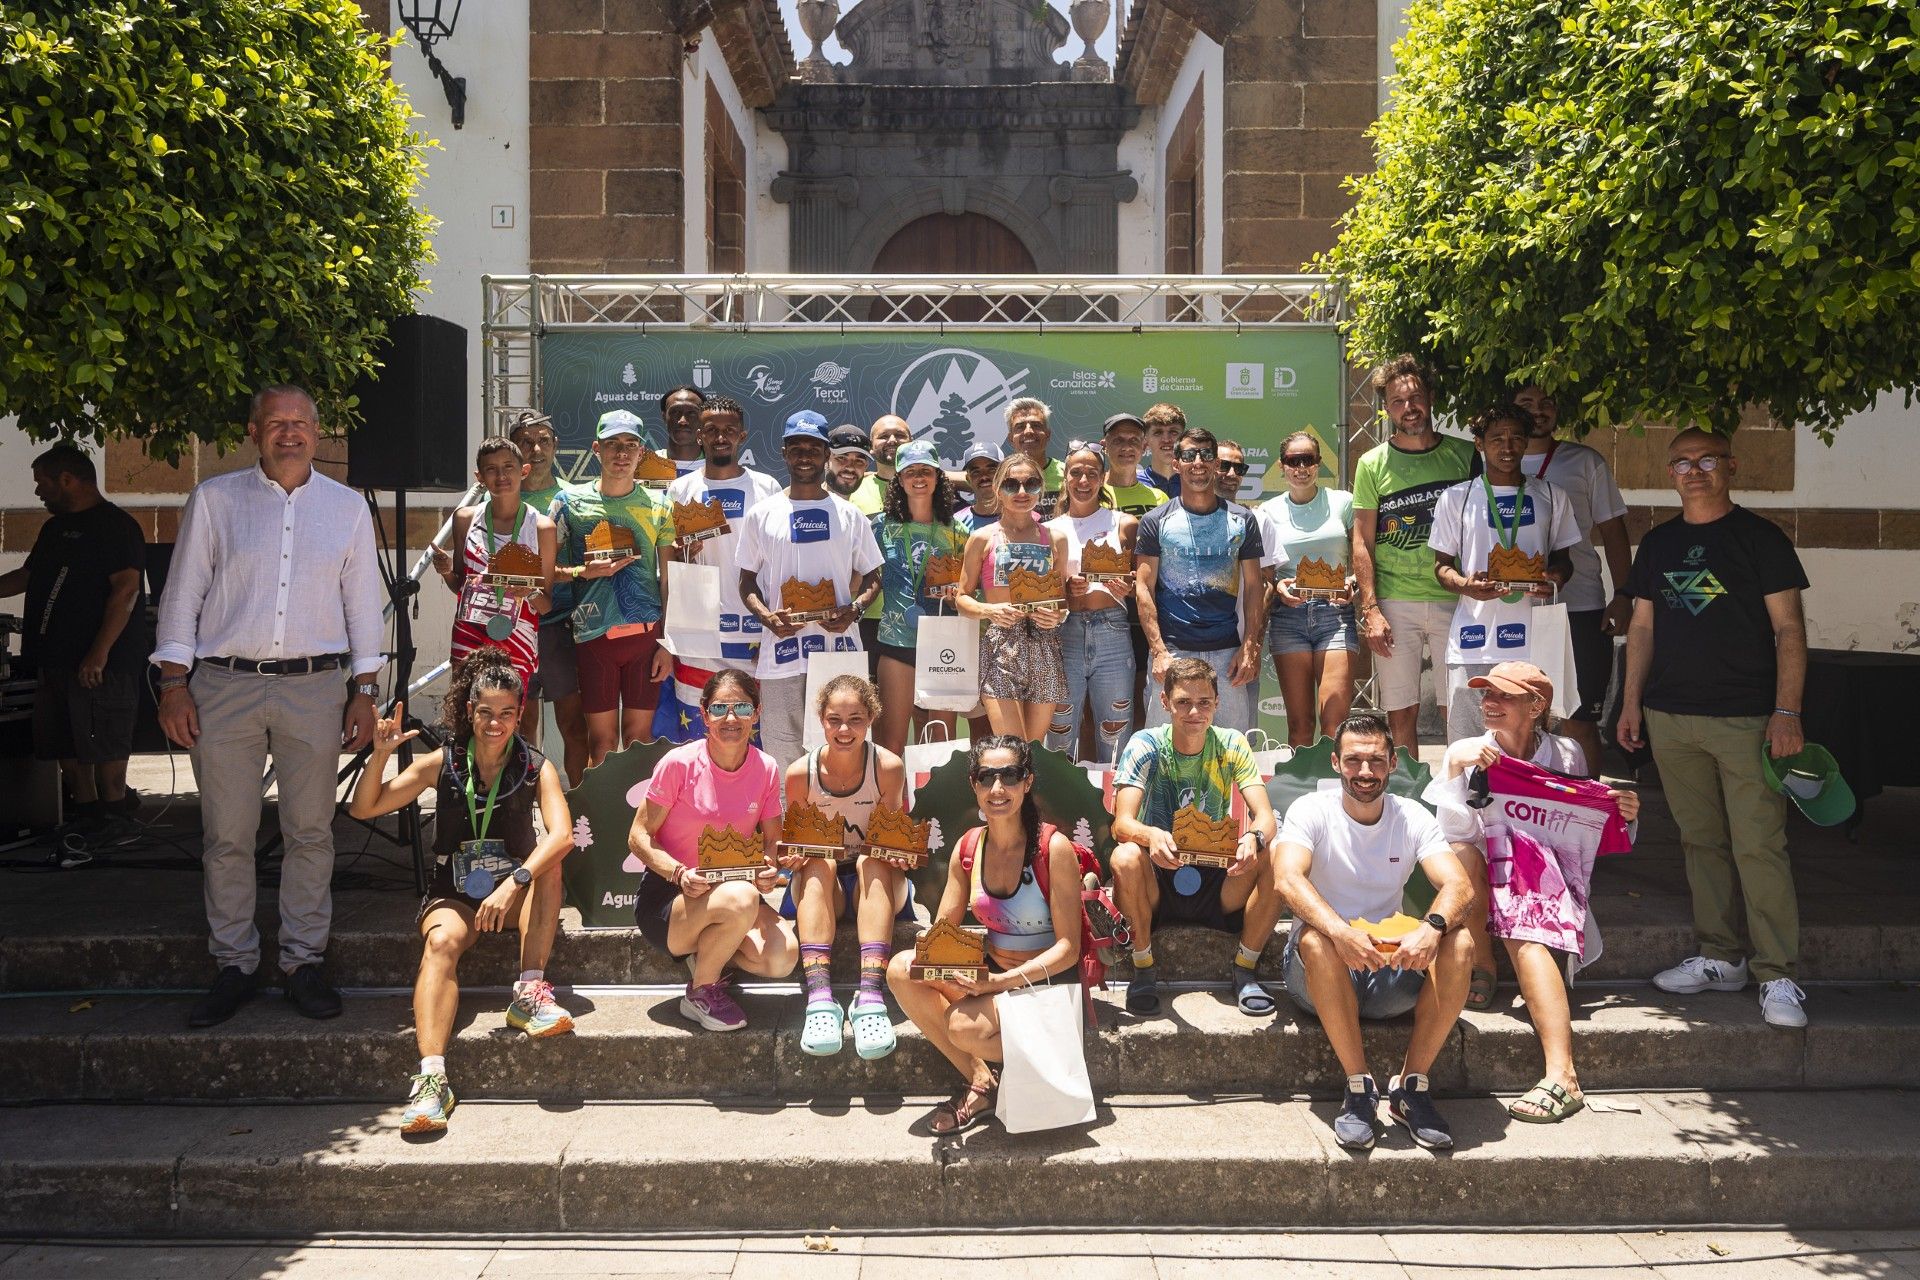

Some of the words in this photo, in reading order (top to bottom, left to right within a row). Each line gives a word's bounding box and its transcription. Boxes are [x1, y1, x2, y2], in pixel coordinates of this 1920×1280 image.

[499, 210, 506, 223] 1
[1072, 371, 1097, 380] Islas
[1050, 379, 1097, 388] Canarias
[1170, 384, 1203, 392] Canarias
[595, 392, 625, 404] Aguas
[627, 392, 639, 401] de
[640, 391, 665, 400] Teror
[814, 387, 845, 398] Teror
[704, 495, 742, 508] Eicela
[1496, 502, 1532, 515] Emila
